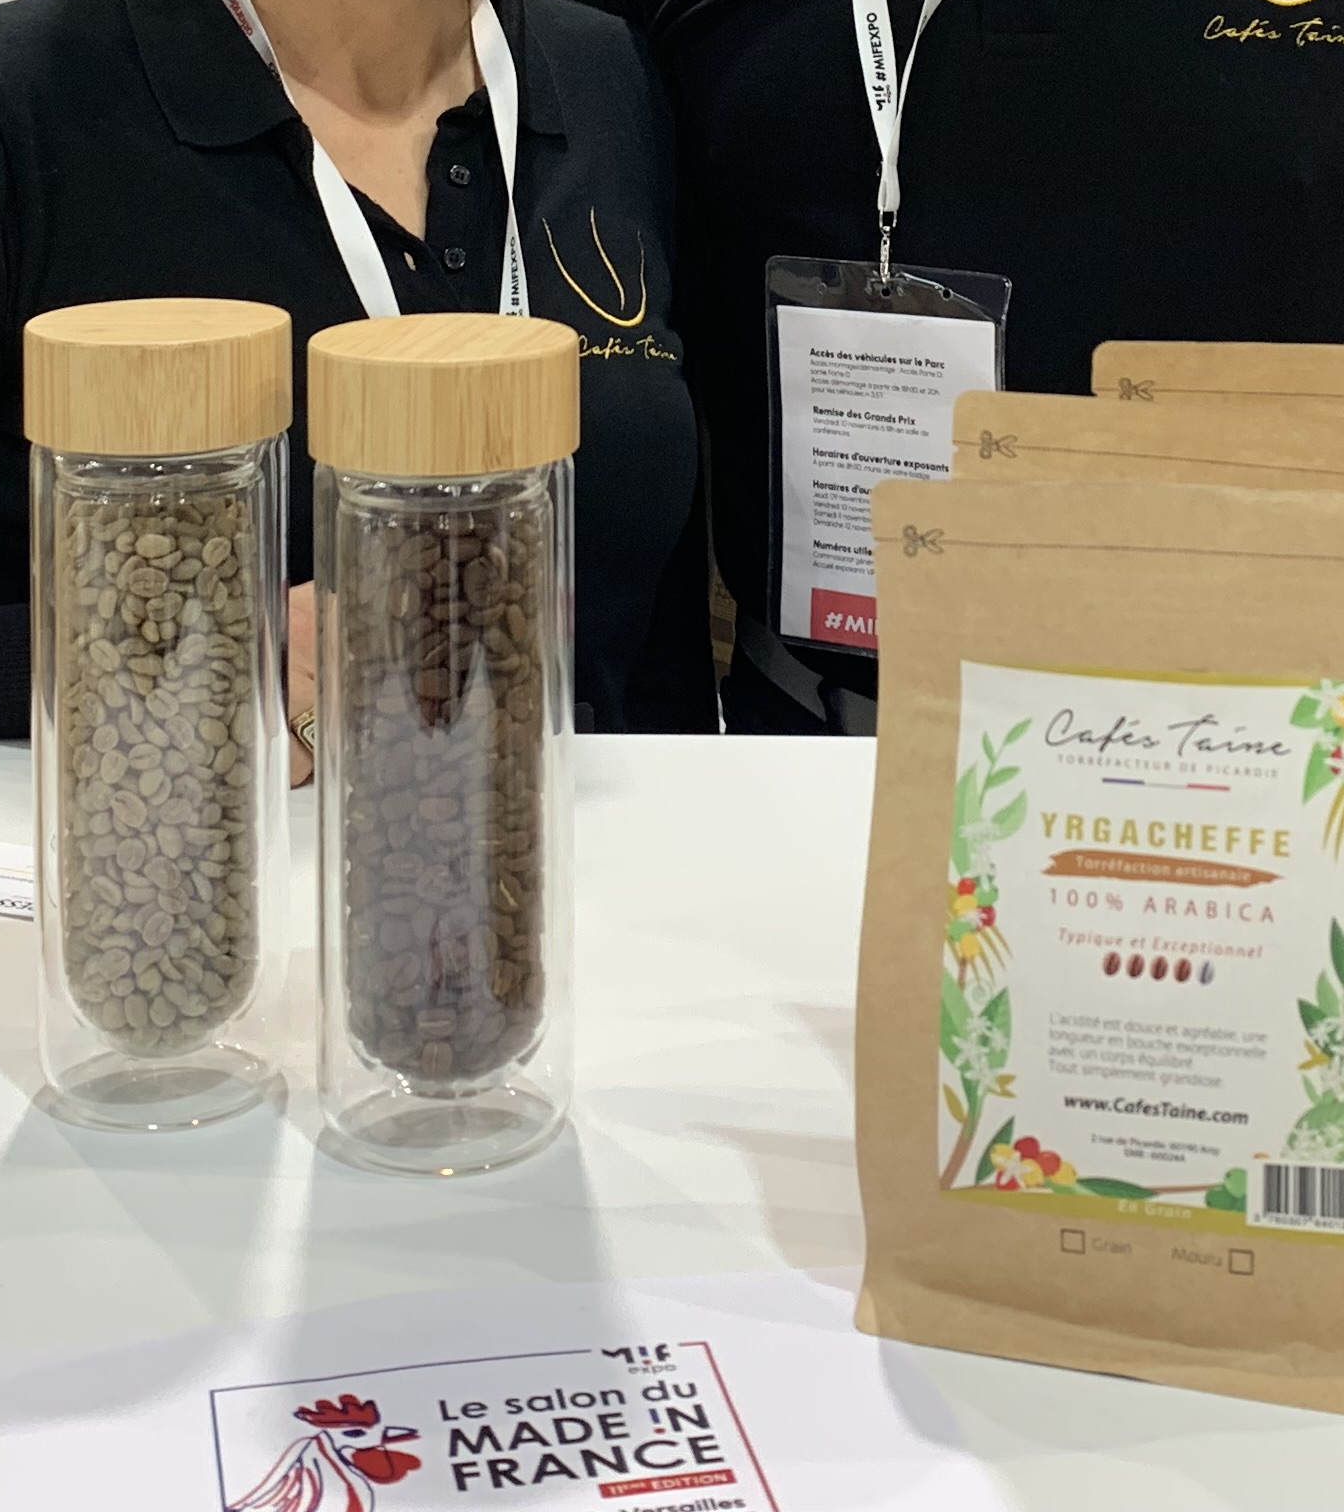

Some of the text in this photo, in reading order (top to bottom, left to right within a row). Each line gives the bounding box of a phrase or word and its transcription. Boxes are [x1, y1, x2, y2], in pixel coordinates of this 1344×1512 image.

[1203, 14, 1282, 43] Cafés
[866, 12, 887, 82] #MIFEXPO
[810, 348, 945, 369] Accès des véhicules sur le Parc
[813, 406, 916, 425] Remise des Grands Prix
[813, 448, 949, 472] Horaires d'ouverture exposants
[813, 480, 849, 492] Horaires
[813, 540, 851, 553] Numéros
[1044, 708, 1292, 758] Cafés Taine
[1178, 761, 1198, 774] DE
[1206, 763, 1280, 779] PICARDIE
[1040, 810, 1291, 858] YRGACHEFFE
[1075, 854, 1253, 884] Torréfaction artisanale
[1049, 888, 1276, 925] 100% ARABICA
[1058, 927, 1264, 960] Typique et Exceptionnel
[1063, 1095, 1249, 1126] www.CafesTaine.com
[1118, 1200, 1193, 1219] En Grain
[1092, 1238, 1132, 1255] Grain
[628, 1362, 677, 1375] expo
[439, 1380, 698, 1421] Le salon du
[448, 1412, 630, 1458] MADE
[451, 1434, 725, 1492] FRANCE
